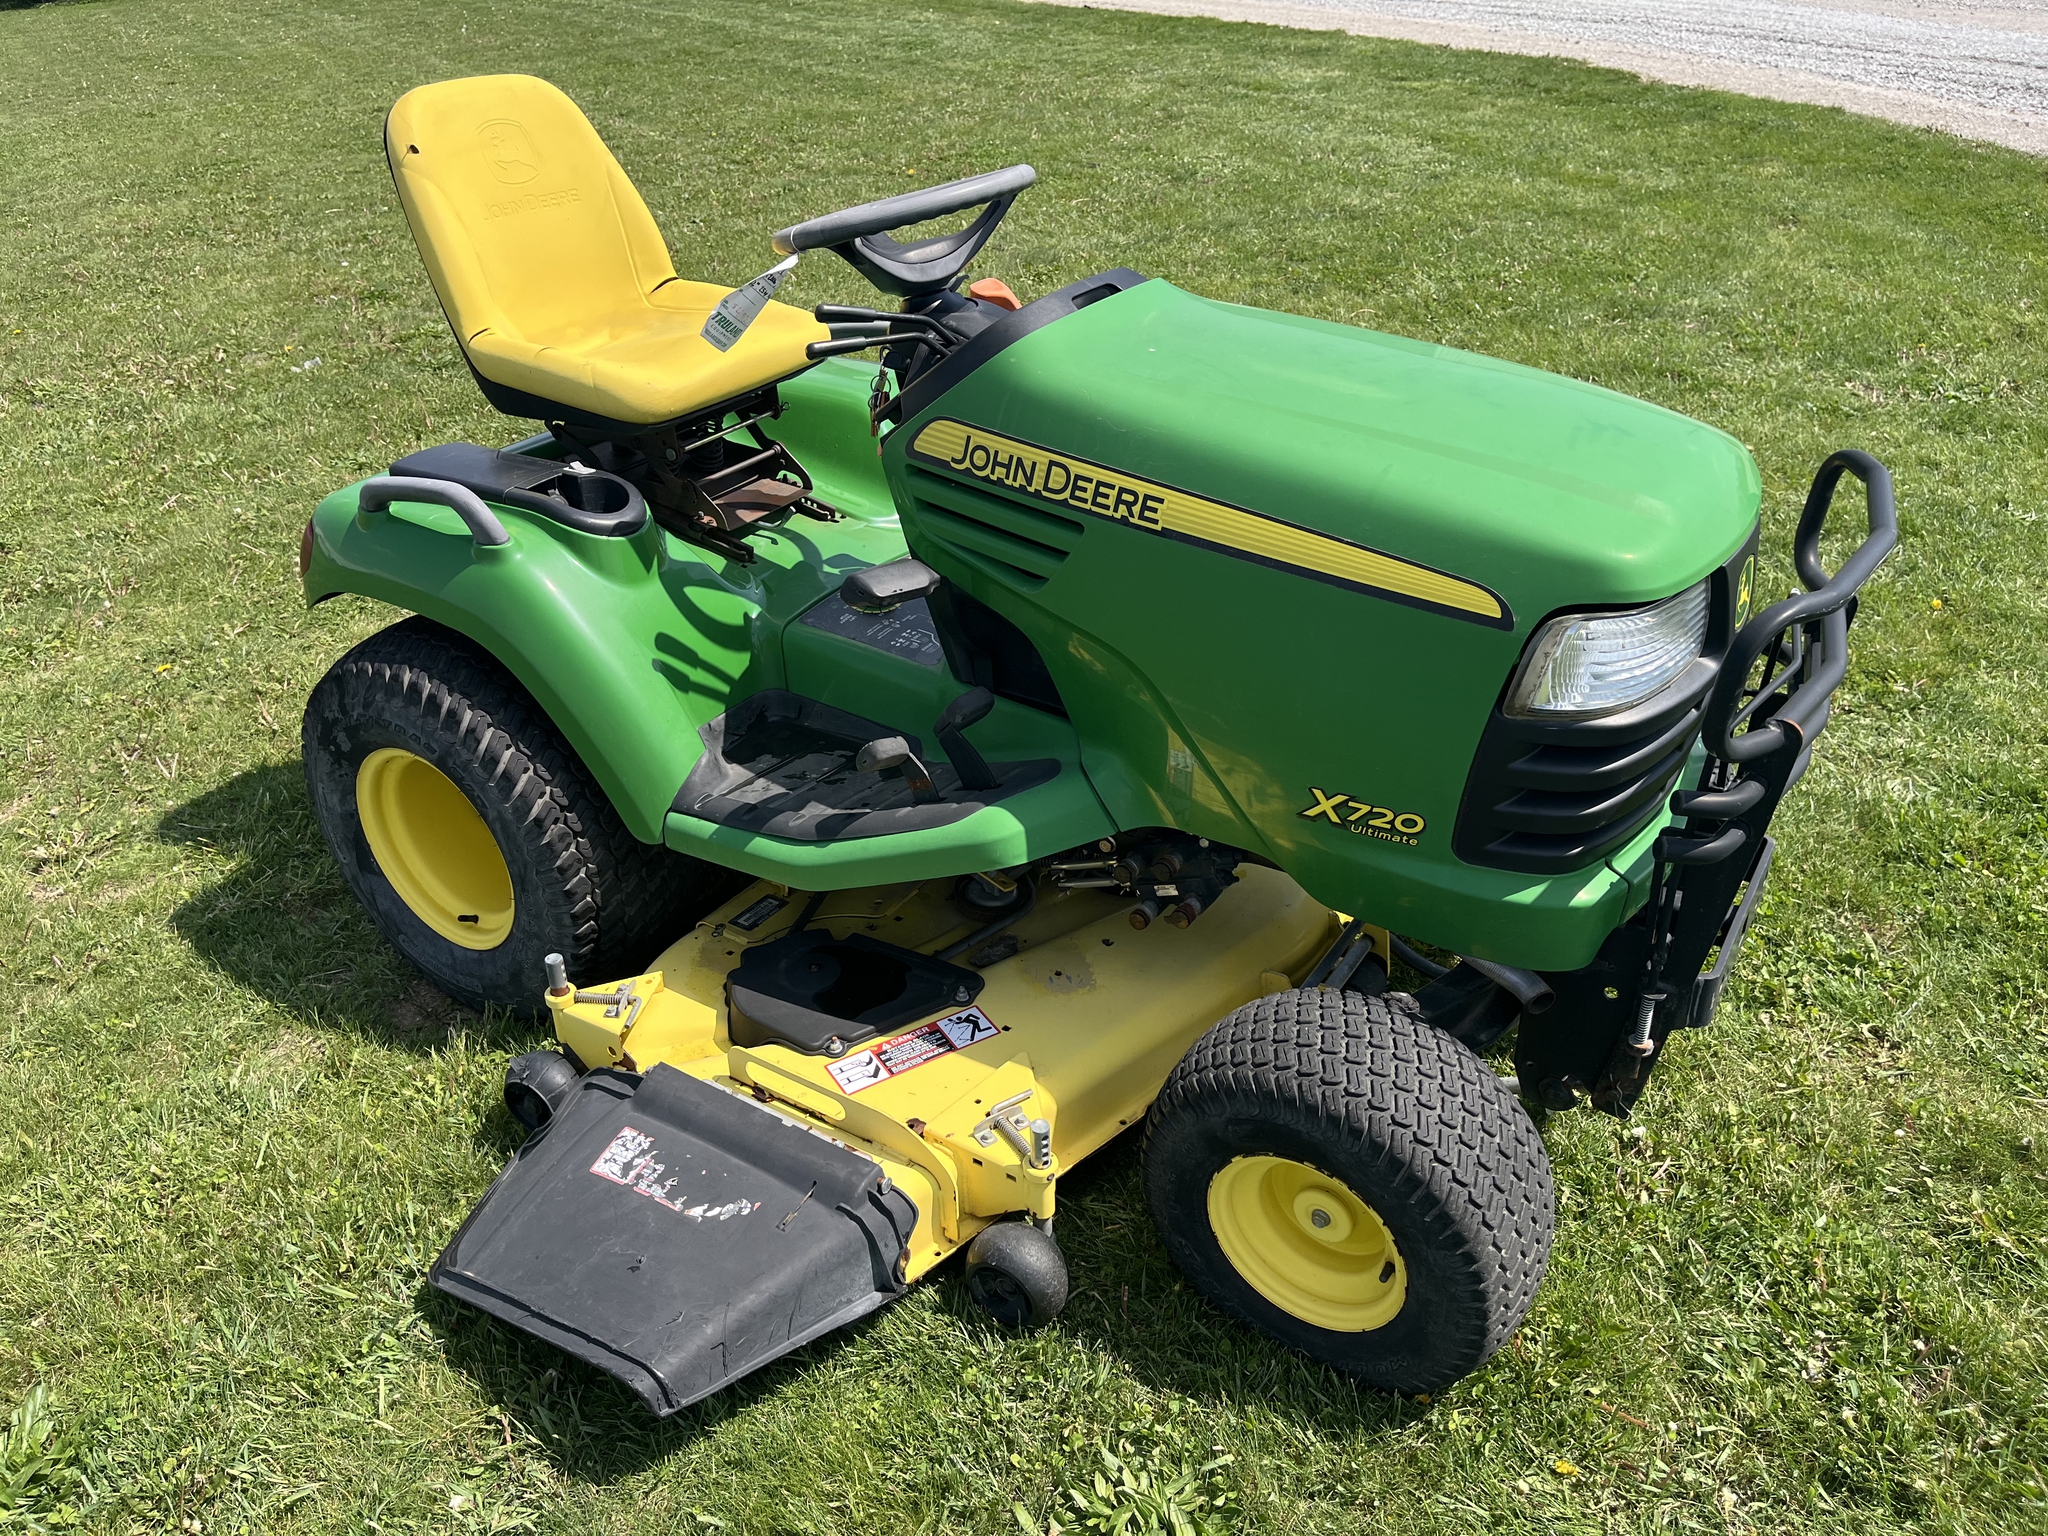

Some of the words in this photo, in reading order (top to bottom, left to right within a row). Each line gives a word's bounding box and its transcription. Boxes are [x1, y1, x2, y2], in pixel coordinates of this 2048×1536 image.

[484, 199, 525, 222] JOHN
[524, 188, 582, 213] DEERE
[711, 311, 743, 338] TRULAND
[950, 435, 1038, 489] JOHN
[1042, 459, 1166, 527] DEERE
[1301, 787, 1425, 834] X720
[1350, 823, 1418, 846] Ultimate
[891, 1026, 930, 1046] DANGER
